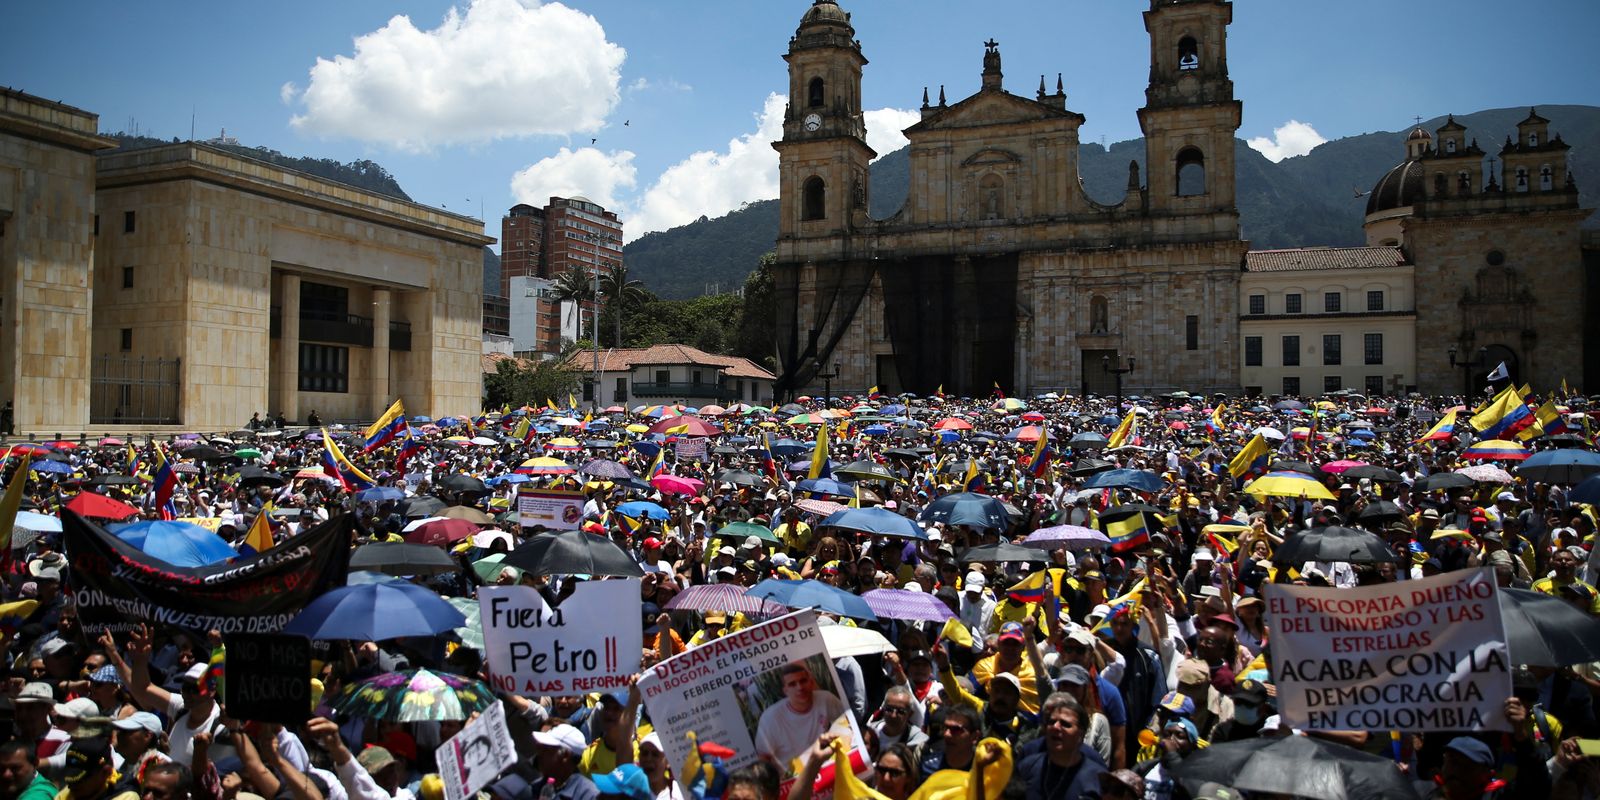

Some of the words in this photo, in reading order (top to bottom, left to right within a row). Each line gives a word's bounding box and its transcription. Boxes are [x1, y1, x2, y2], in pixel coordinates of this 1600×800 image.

[1270, 598, 1289, 614] EL
[1296, 597, 1406, 614] PSICOPATA
[1411, 580, 1494, 607] DUEÑO
[153, 605, 245, 634] NUESTROS
[1280, 617, 1314, 634] DEL
[1319, 610, 1422, 632] UNIVERSO
[1428, 608, 1439, 624] Y
[1446, 603, 1484, 622] LAS
[234, 640, 260, 662] NO
[510, 639, 598, 674] Petro
[605, 636, 618, 673] !!
[655, 615, 801, 681] DESAPARECIDO
[1332, 630, 1432, 653] ESTRELLAS
[646, 686, 662, 698] EN
[664, 666, 715, 691] BOGOTA,
[716, 658, 730, 670] EL
[732, 641, 780, 664] PASADO
[781, 634, 797, 647] 12
[799, 627, 816, 641] DE
[683, 676, 734, 700] FEBRERO
[735, 666, 757, 681] DEL
[760, 653, 789, 672] 2024
[1280, 657, 1378, 682] ACABA
[1386, 651, 1457, 676] CON
[1470, 647, 1508, 673] LA
[238, 673, 305, 704] ABORTO
[491, 673, 516, 692] NO
[525, 680, 536, 692] A
[539, 679, 564, 692] LAS
[1304, 681, 1484, 707] DEMOCRACIA
[700, 699, 721, 714] AÑOS
[1308, 711, 1337, 729] EN
[1346, 706, 1485, 729] COLOMBIA
[494, 722, 510, 764] BUSCA
